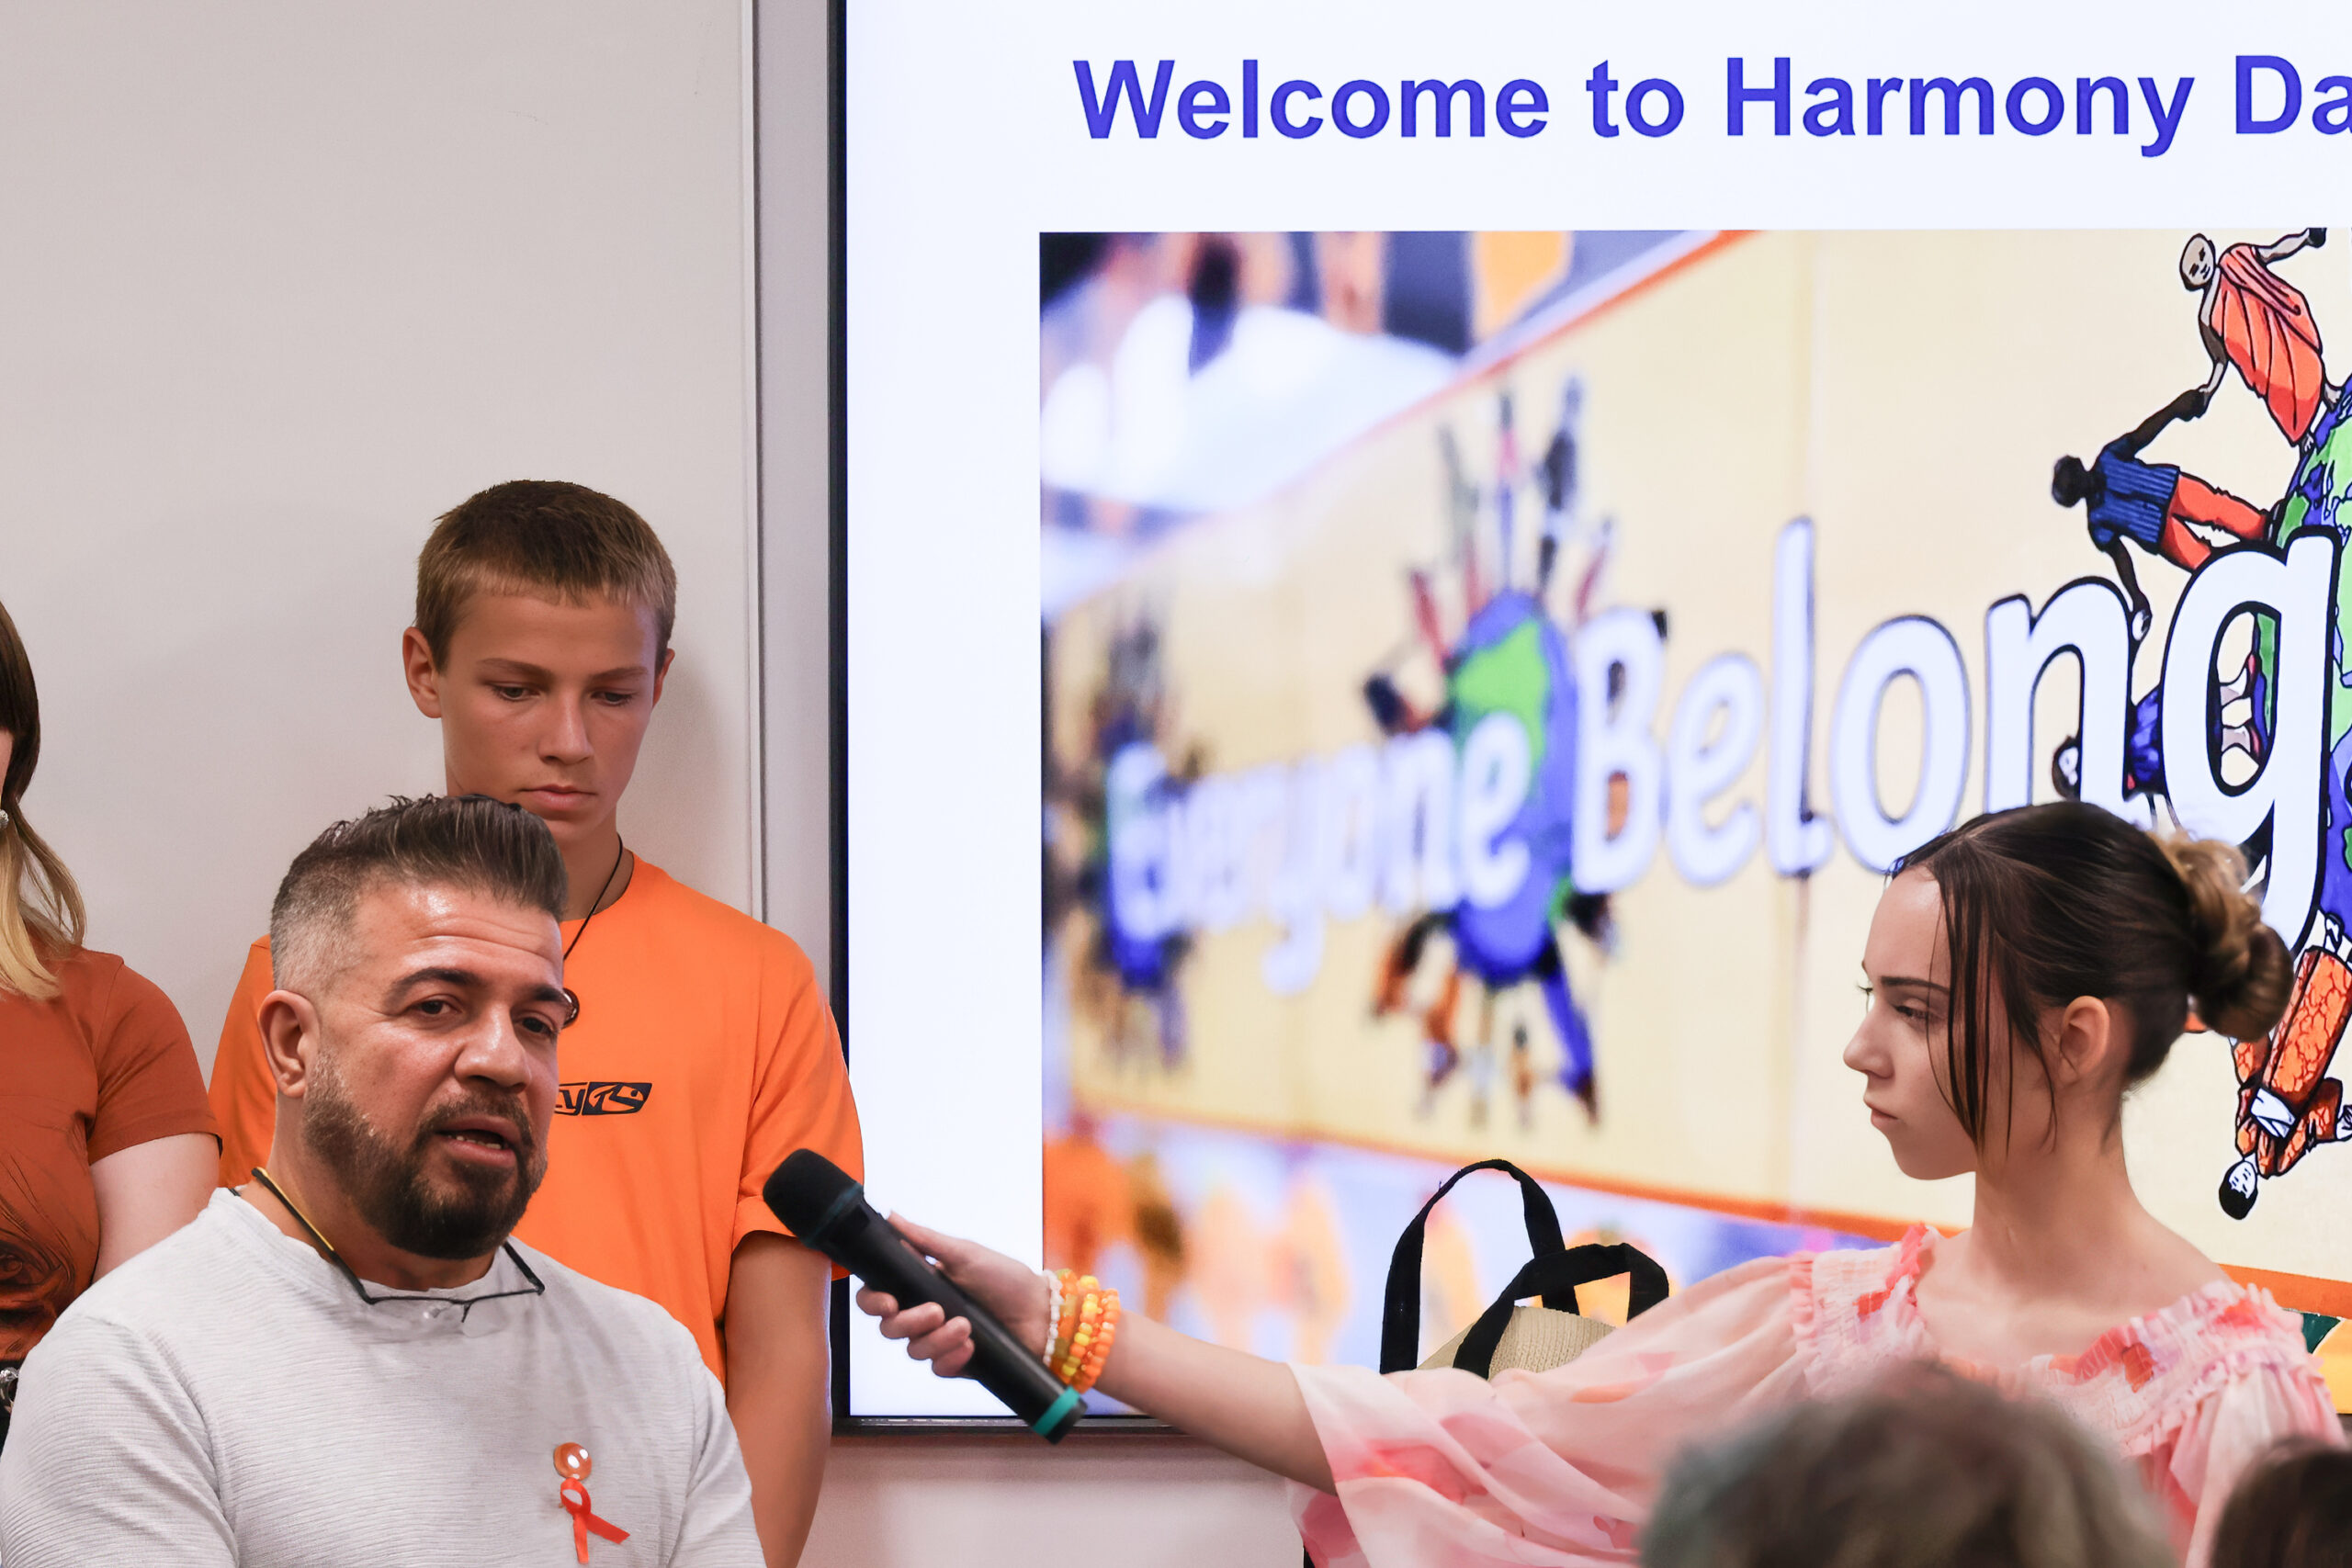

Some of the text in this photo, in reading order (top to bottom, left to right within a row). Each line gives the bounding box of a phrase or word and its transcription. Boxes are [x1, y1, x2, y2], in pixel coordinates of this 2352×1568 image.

[1072, 59, 1550, 140] Welcome
[1585, 60, 1685, 138] to
[1726, 56, 2196, 158] Harmony
[1105, 711, 1532, 996] Everyone
